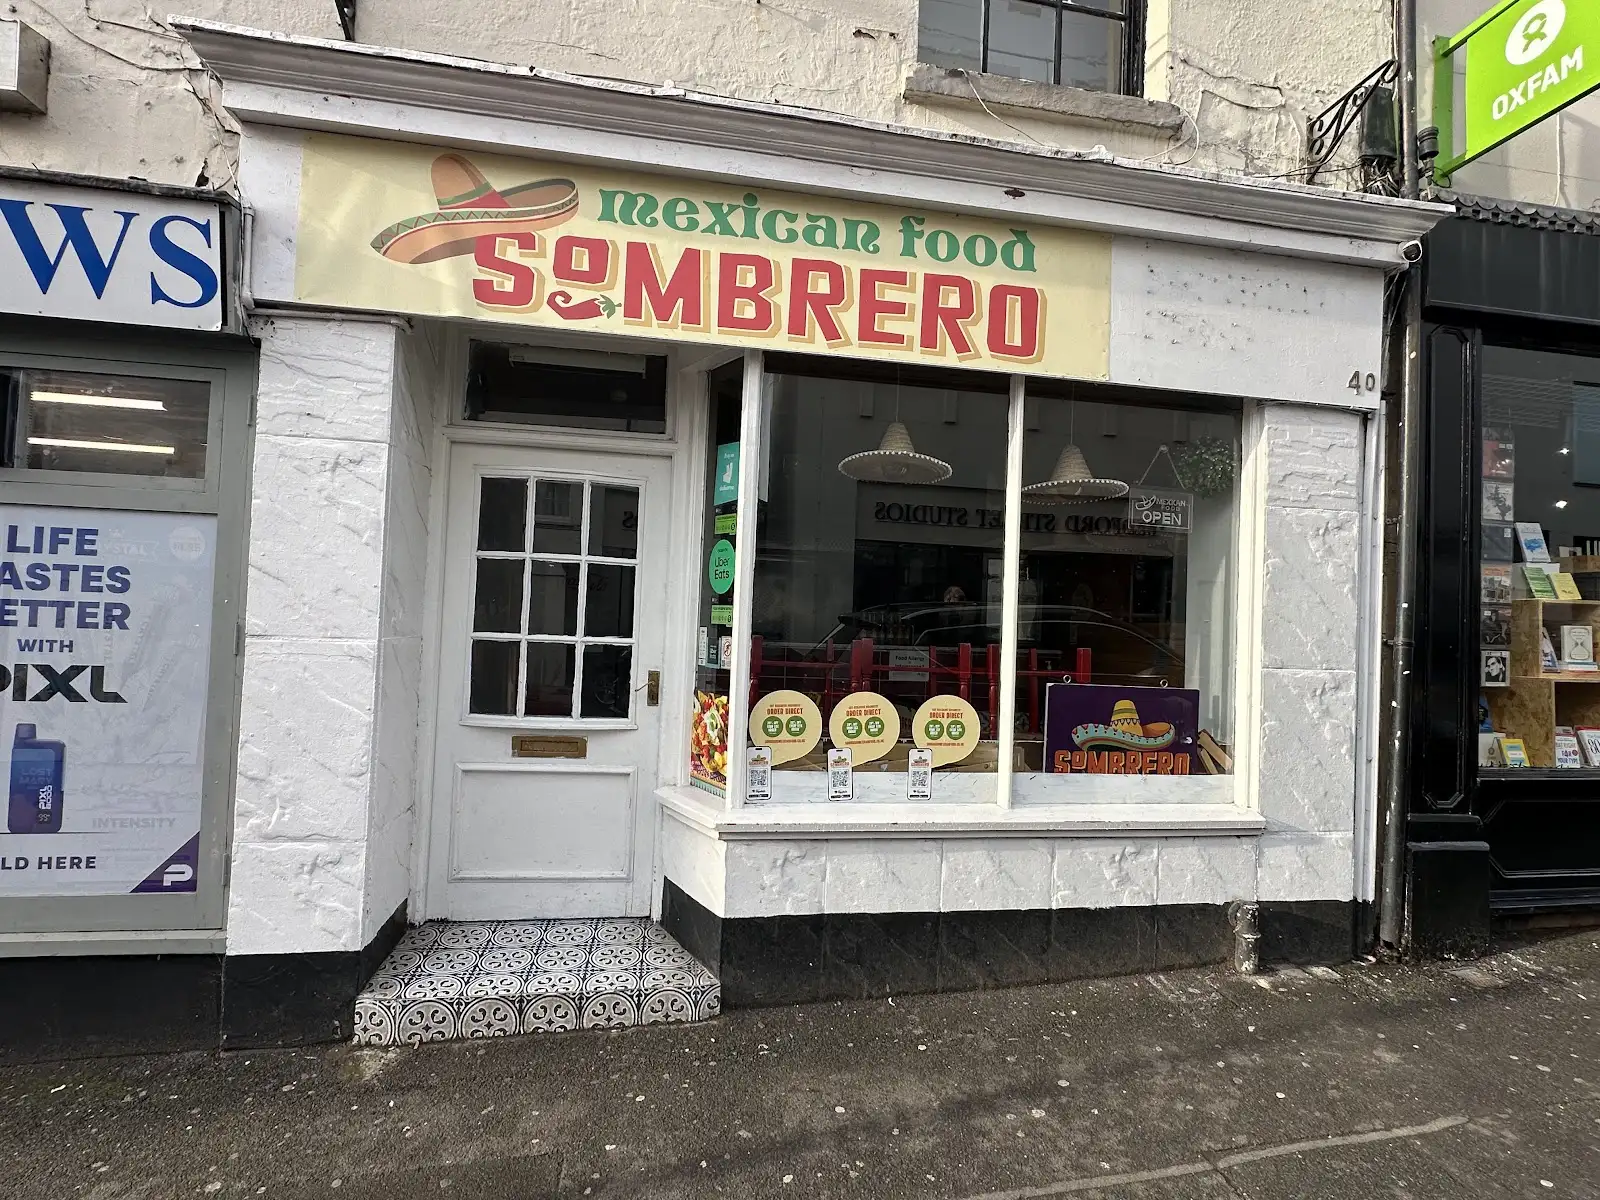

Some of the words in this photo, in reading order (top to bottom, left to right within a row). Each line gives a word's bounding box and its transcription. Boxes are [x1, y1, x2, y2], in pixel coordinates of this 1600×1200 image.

[1492, 44, 1583, 120] OXFAM
[597, 188, 883, 255] mexican
[898, 215, 1038, 274] food
[0, 198, 219, 308] WS
[471, 231, 1048, 366] SOMBRERO
[1347, 370, 1376, 396] 40
[1142, 510, 1182, 526] OPEN
[7, 525, 99, 556] LIFE
[714, 557, 731, 568] Uber
[714, 569, 730, 580] Eats
[0, 562, 131, 594] ASTES
[0, 599, 131, 630] ETTER
[17, 639, 74, 653] WITH
[1053, 750, 1190, 775] SOMBRERO
[39, 786, 48, 809] PIXL
[1, 856, 29, 870] LD
[38, 856, 96, 870] HERE
